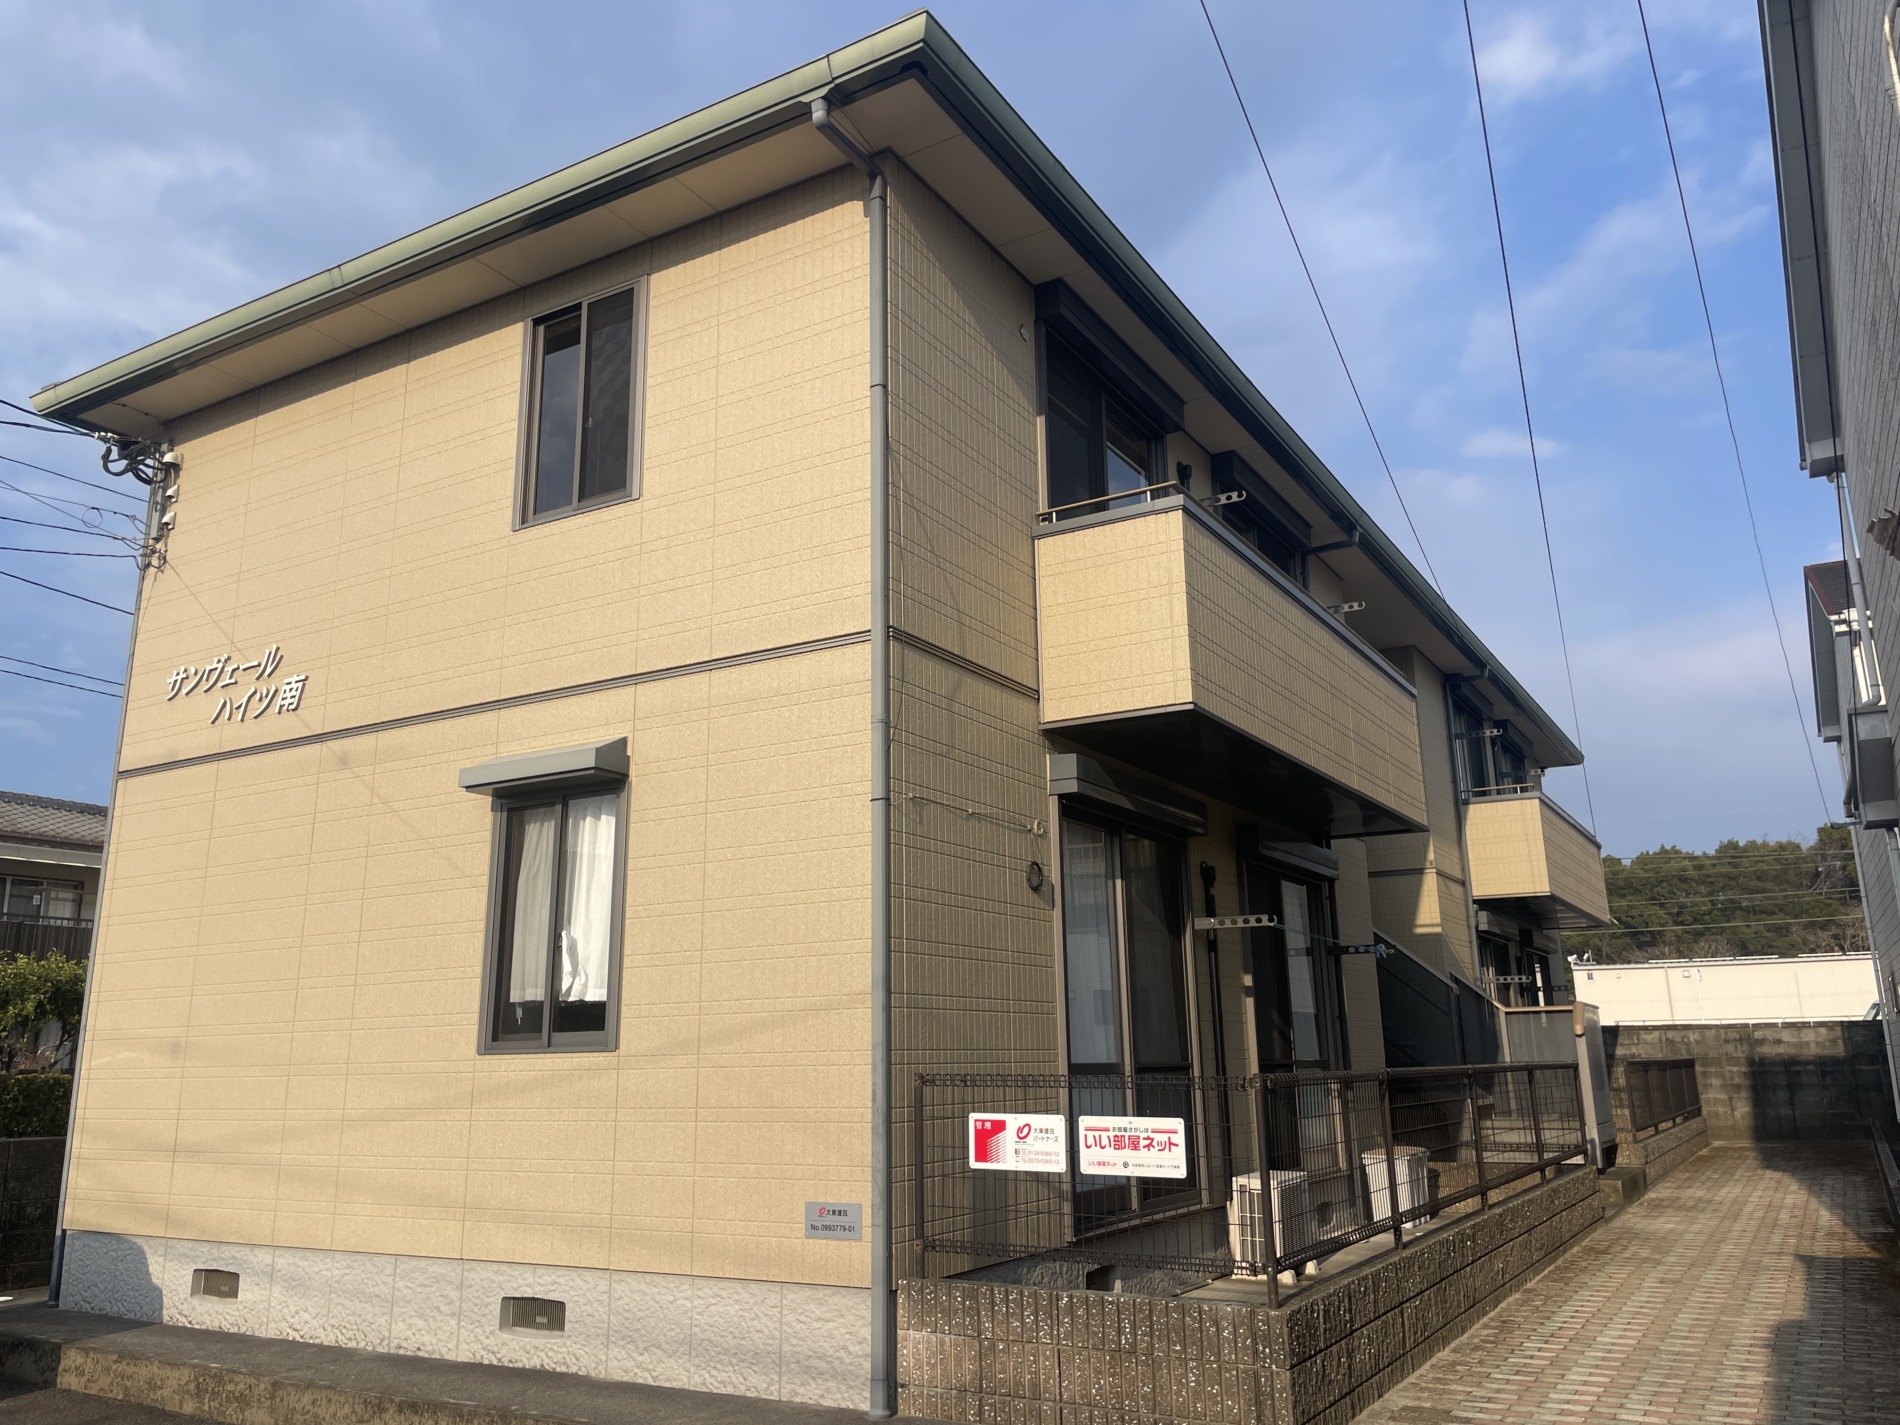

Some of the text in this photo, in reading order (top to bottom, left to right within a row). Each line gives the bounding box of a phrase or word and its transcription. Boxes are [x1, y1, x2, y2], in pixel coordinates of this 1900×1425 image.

[210, 674, 308, 724] ハイツ南
[1084, 1133, 1180, 1153] いい部屋ネット
